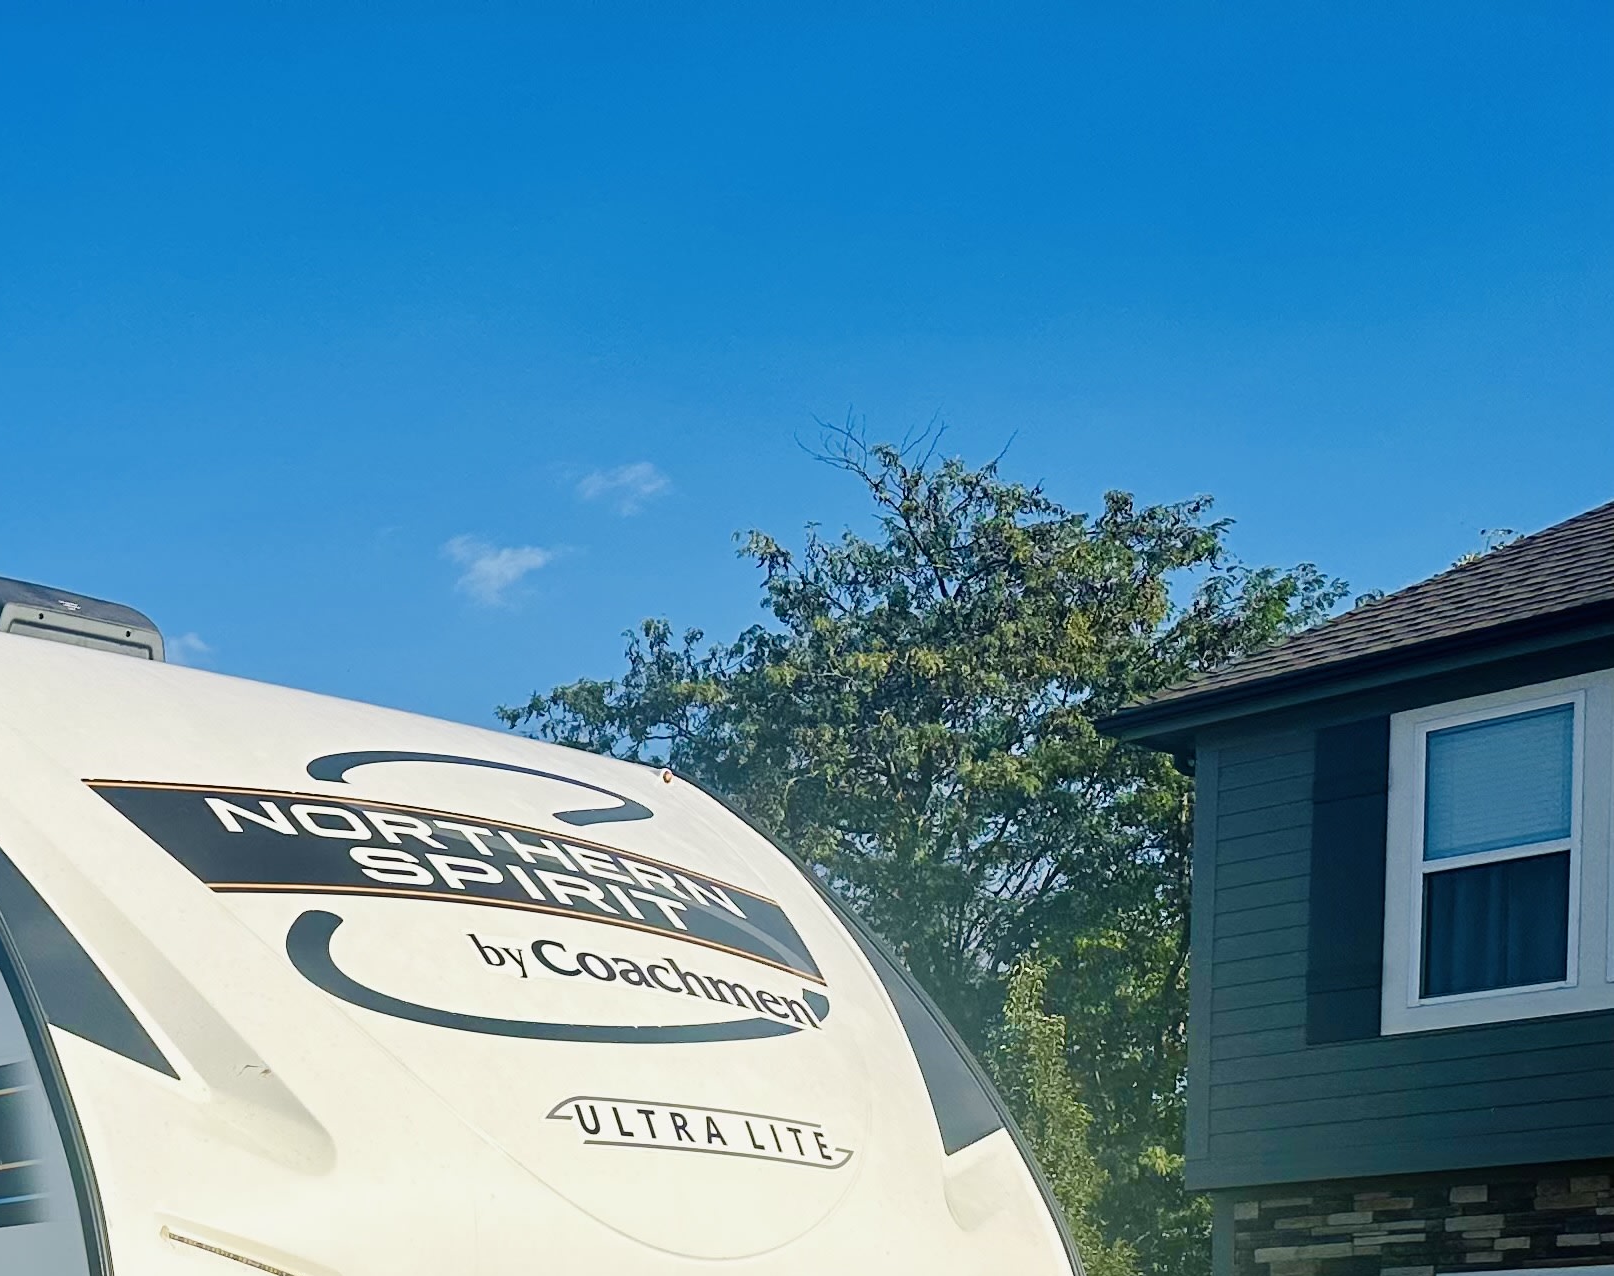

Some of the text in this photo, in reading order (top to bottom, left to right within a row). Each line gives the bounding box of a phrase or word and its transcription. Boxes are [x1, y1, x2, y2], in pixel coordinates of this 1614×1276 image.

[204, 797, 747, 920] NORTHERN
[349, 846, 688, 931] SPIRIT
[466, 933, 823, 1030] by Coachmen
[574, 1104, 833, 1161] ULTRA LITE
